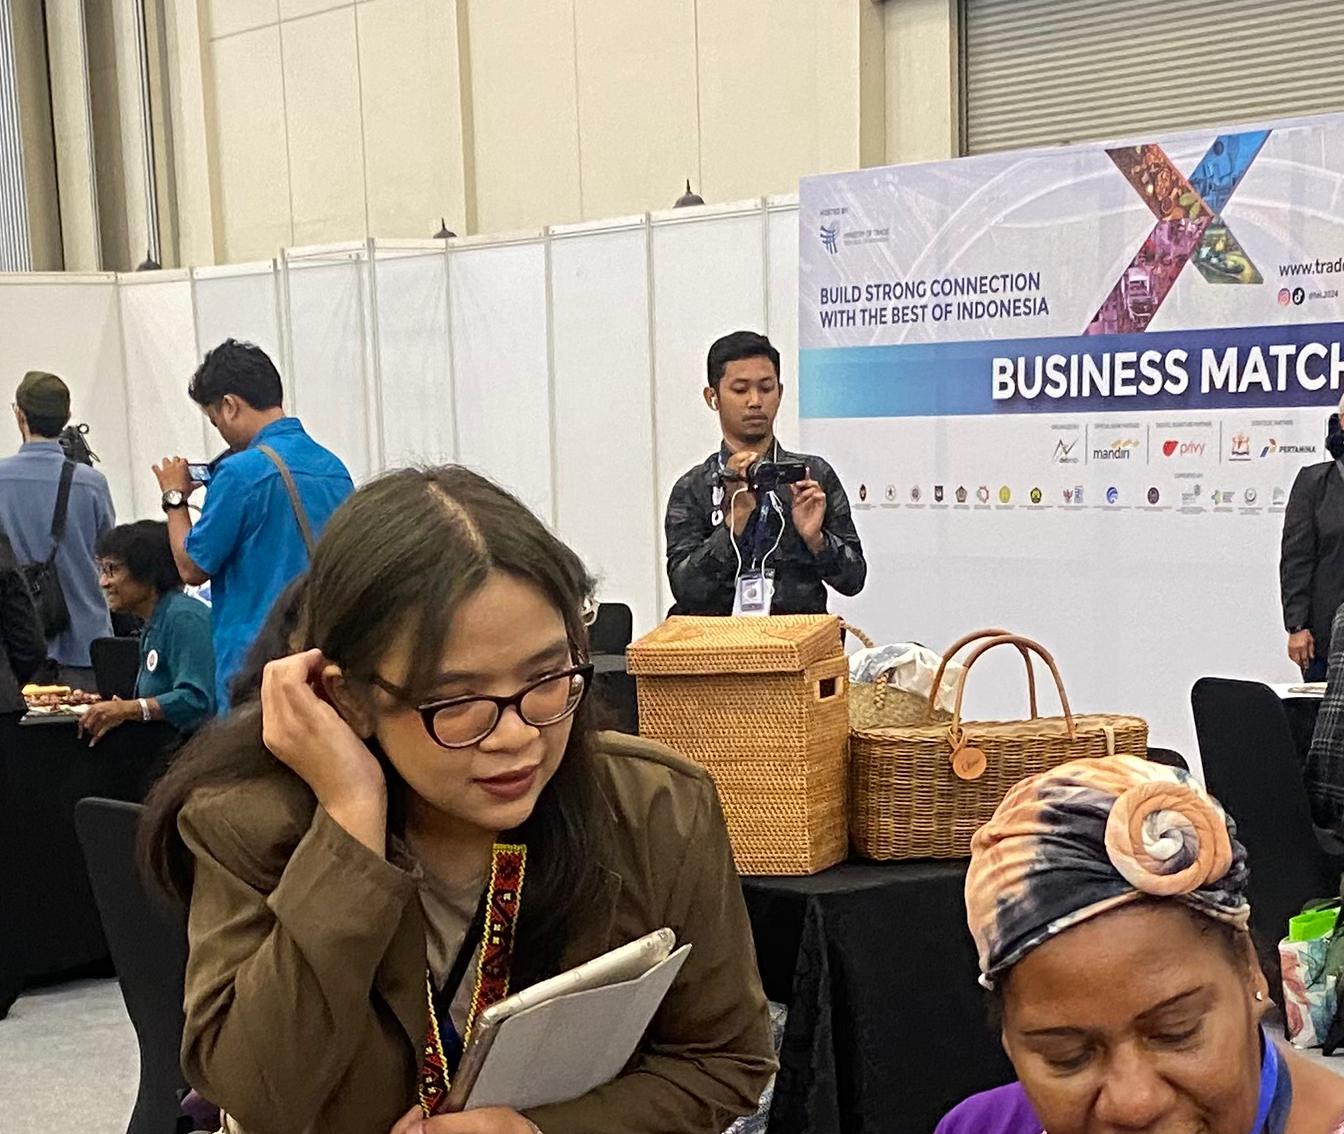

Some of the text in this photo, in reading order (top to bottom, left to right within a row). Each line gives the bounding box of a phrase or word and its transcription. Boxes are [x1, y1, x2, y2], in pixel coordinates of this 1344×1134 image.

[820, 271, 1041, 305] BUILD STRONG CONNECTION
[820, 297, 1050, 328] WITH THE BEST OF INDONESIA
[991, 348, 1190, 400] BUSINESS
